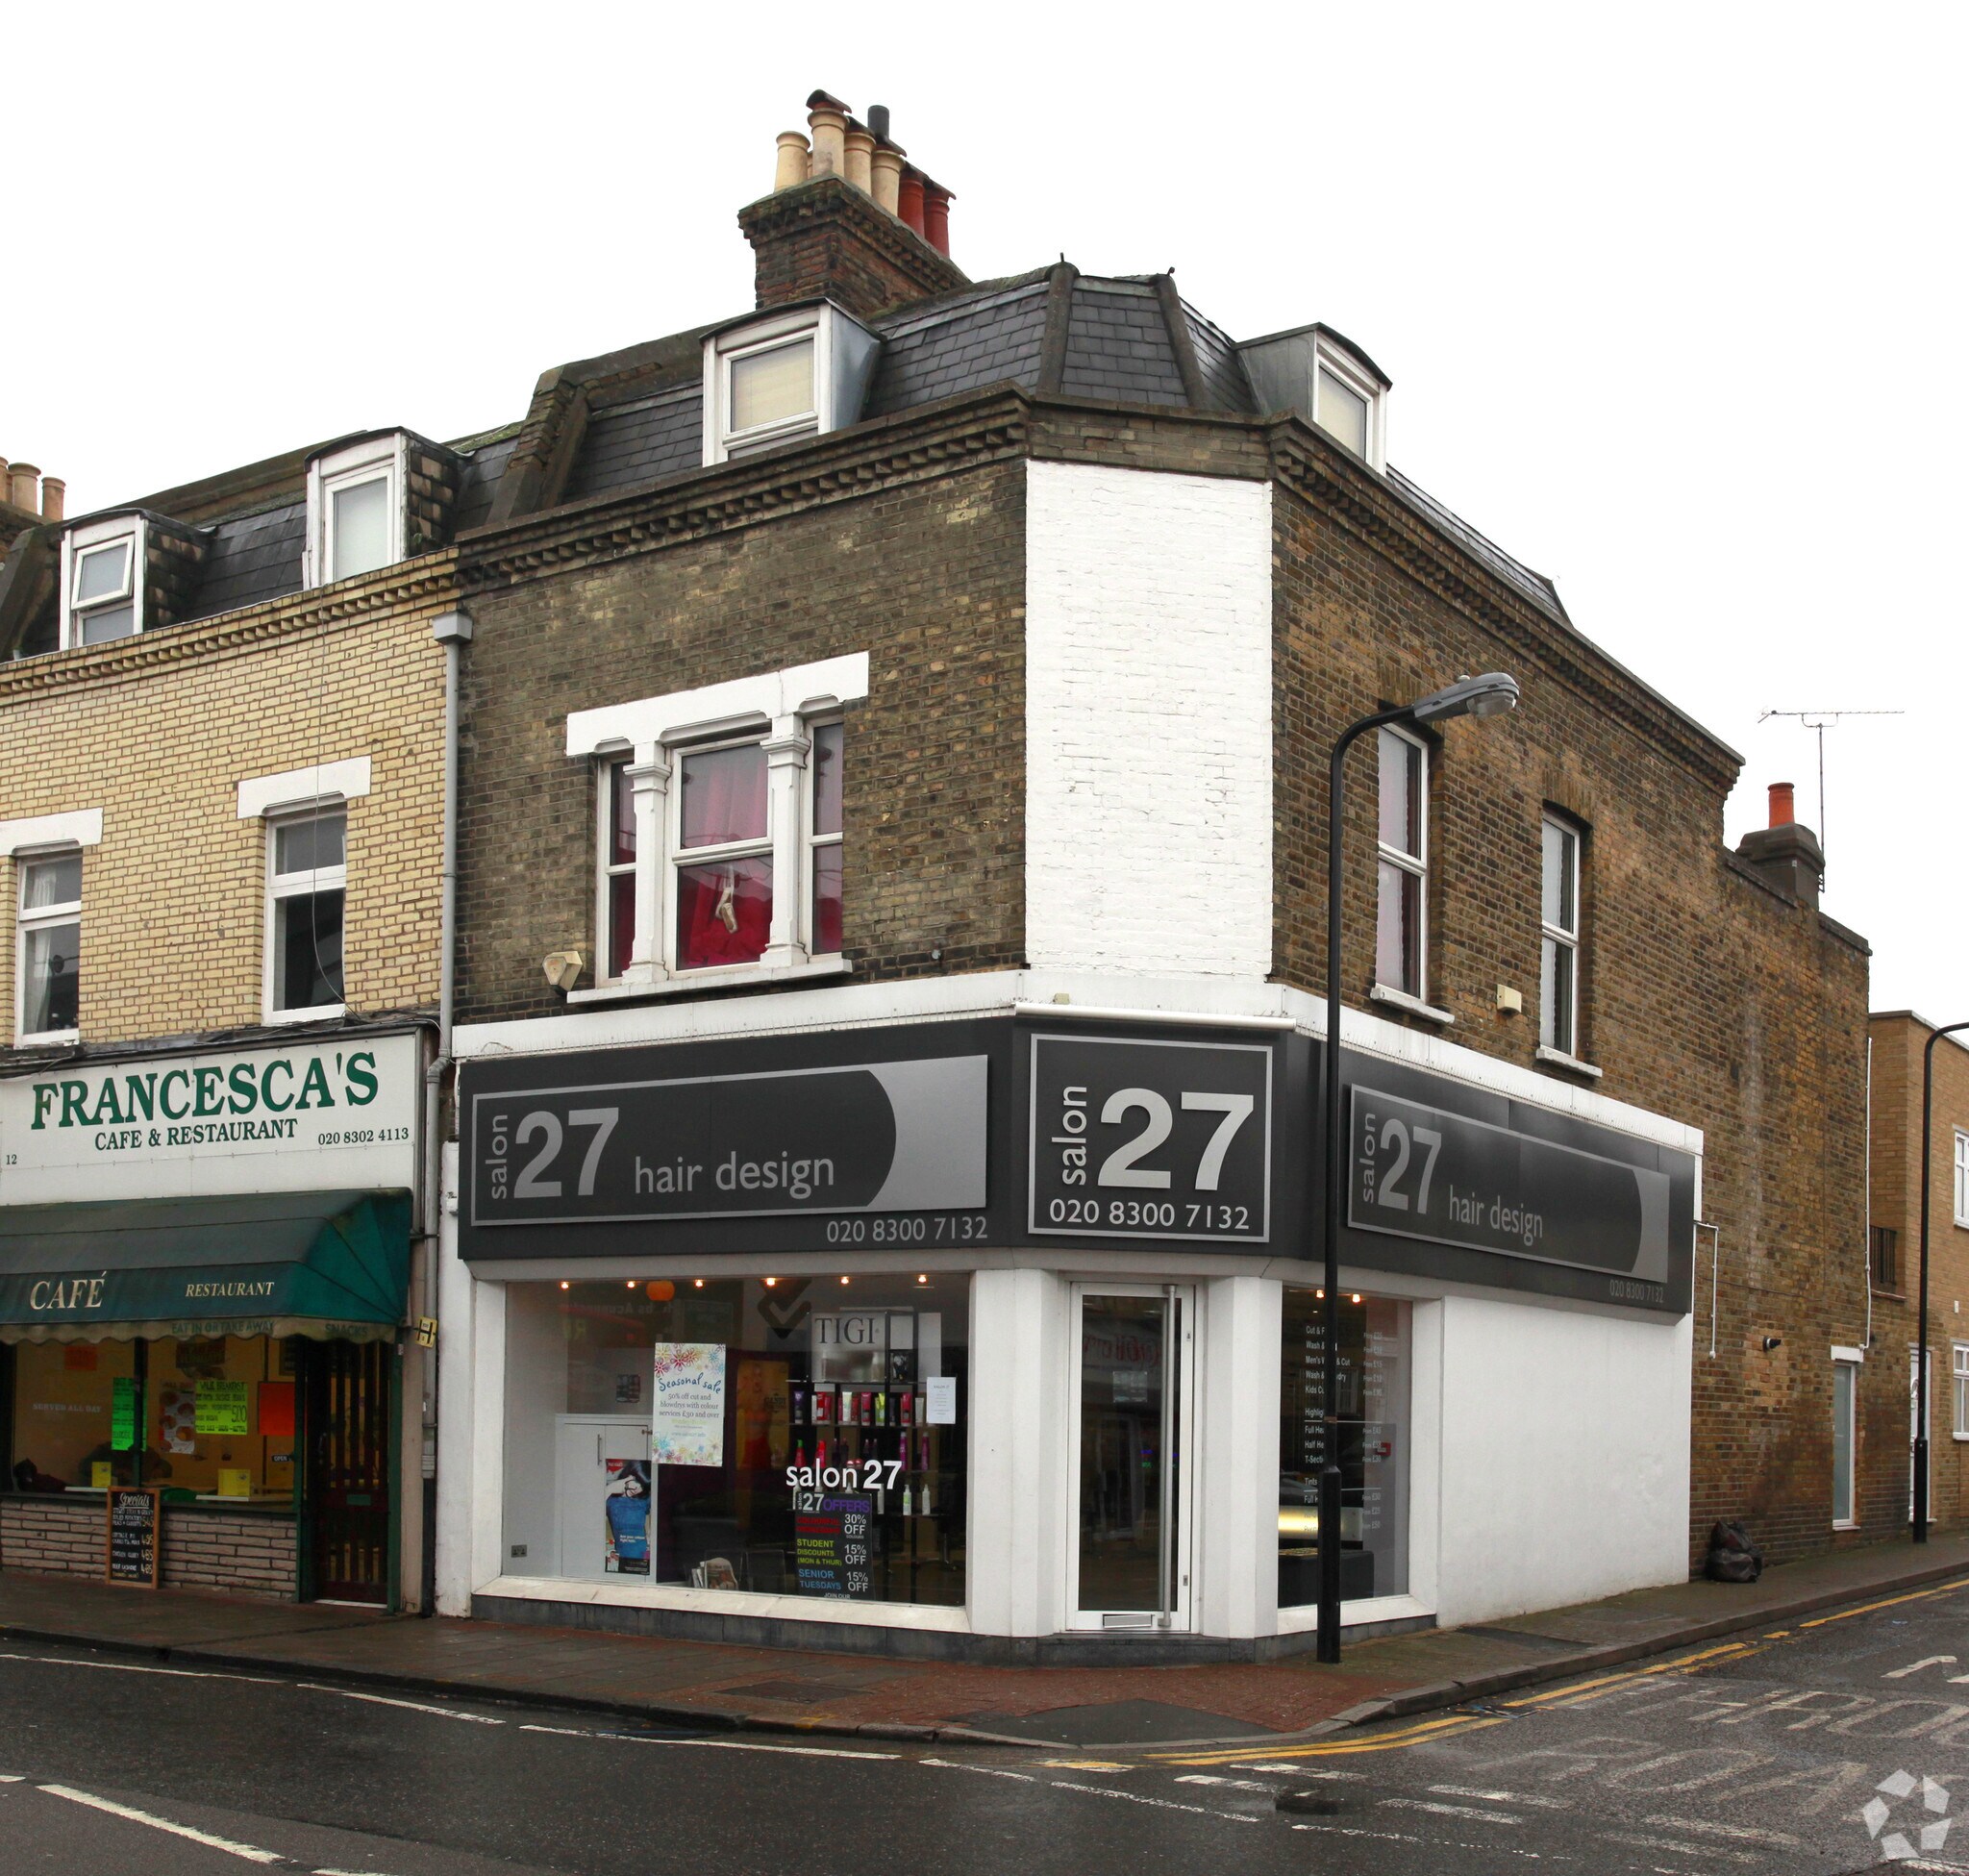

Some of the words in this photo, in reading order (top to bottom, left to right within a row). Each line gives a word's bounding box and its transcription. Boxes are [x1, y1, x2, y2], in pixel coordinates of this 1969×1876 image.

[31, 1051, 379, 1130] FRANCESCA'S
[94, 1130, 142, 1151] CAFE
[148, 1128, 162, 1147] &
[167, 1118, 298, 1146] RESTAURANT
[317, 1132, 341, 1146] 020
[343, 1130, 375, 1144] 8302
[378, 1127, 410, 1141] 4113
[1051, 1086, 1087, 1186] salon
[1097, 1088, 1254, 1191] 27
[6, 1154, 17, 1165] 12
[486, 1113, 509, 1200] salon
[513, 1107, 619, 1199] 27
[1358, 1113, 1376, 1204] salon
[1378, 1118, 1442, 1214] 27
[635, 1156, 703, 1194] hair
[715, 1151, 835, 1199] design
[1050, 1198, 1099, 1223] 020
[1109, 1201, 1175, 1227] 8300
[1185, 1204, 1250, 1230] 7132
[1449, 1185, 1483, 1226] hair
[1489, 1195, 1543, 1246] design
[826, 1219, 865, 1242] 020
[872, 1217, 926, 1241] 8300
[935, 1216, 988, 1239] 7132
[29, 1271, 108, 1310] CAFÉ
[185, 1281, 275, 1297] RESTAURANT
[1609, 1279, 1625, 1297] 020
[1625, 1281, 1645, 1300] 8300
[1646, 1285, 1664, 1304] 7132
[171, 1323, 188, 1335] EAT
[325, 1323, 369, 1336] SNACKS
[815, 1317, 874, 1345] TIGI
[659, 1372, 704, 1391] Seasonal
[703, 1380, 721, 1394] sale
[660, 1401, 685, 1411] blowdrys
[682, 1411, 693, 1419] £30
[786, 1458, 858, 1488] salon
[863, 1460, 903, 1490] 27
[119, 1492, 150, 1508] Specials
[803, 1492, 825, 1512] 27
[823, 1500, 871, 1513] OFFERS
[844, 1513, 867, 1525] 30%
[844, 1524, 866, 1536] OFF
[796, 1538, 835, 1548] STUDENT
[796, 1548, 835, 1557] DISCOUNTS
[844, 1543, 867, 1555] 15%
[844, 1554, 867, 1565] OFF
[798, 1569, 835, 1579] SENIOR
[846, 1571, 869, 1583] 15%
[800, 1580, 842, 1590] TUESDAYS
[847, 1582, 869, 1592] OFF
